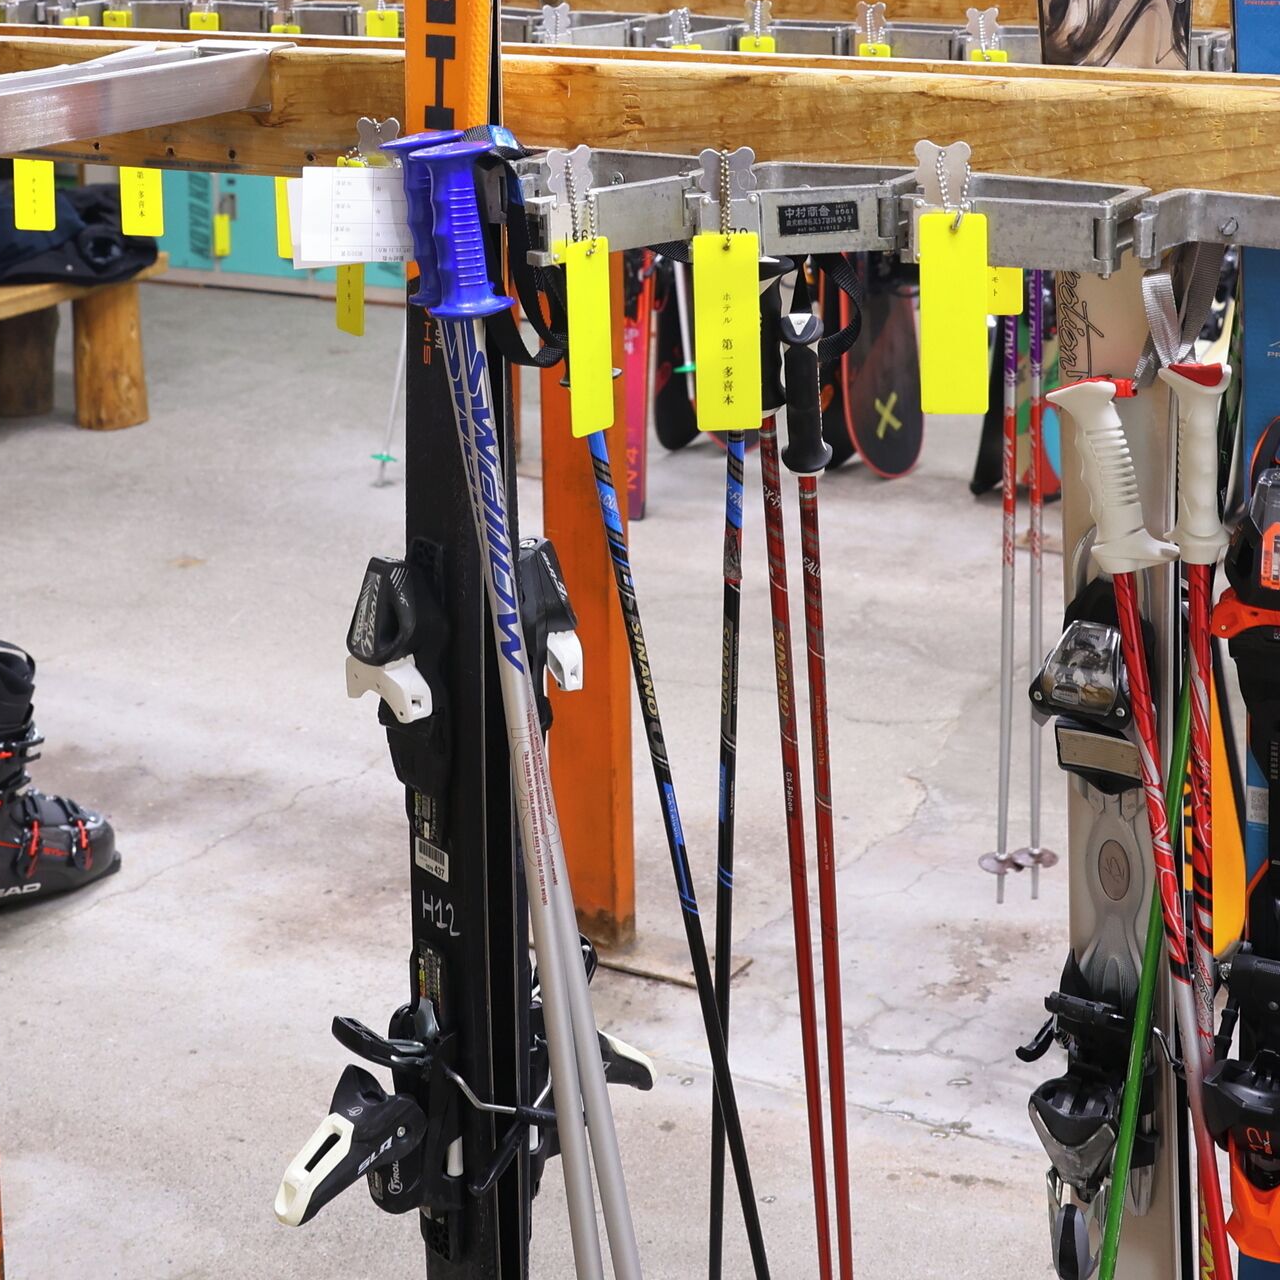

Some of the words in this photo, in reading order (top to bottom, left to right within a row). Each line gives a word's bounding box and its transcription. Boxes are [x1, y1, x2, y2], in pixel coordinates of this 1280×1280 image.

[721, 292, 733, 325] ホテル
[721, 338, 735, 406] 第一多喜本
[630, 621, 658, 717] SINANO
[720, 627, 731, 716] SINANO
[773, 631, 789, 717] SINANO
[434, 865, 445, 878] 437
[422, 890, 461, 937] H12
[388, 1160, 403, 1194] TYROL
